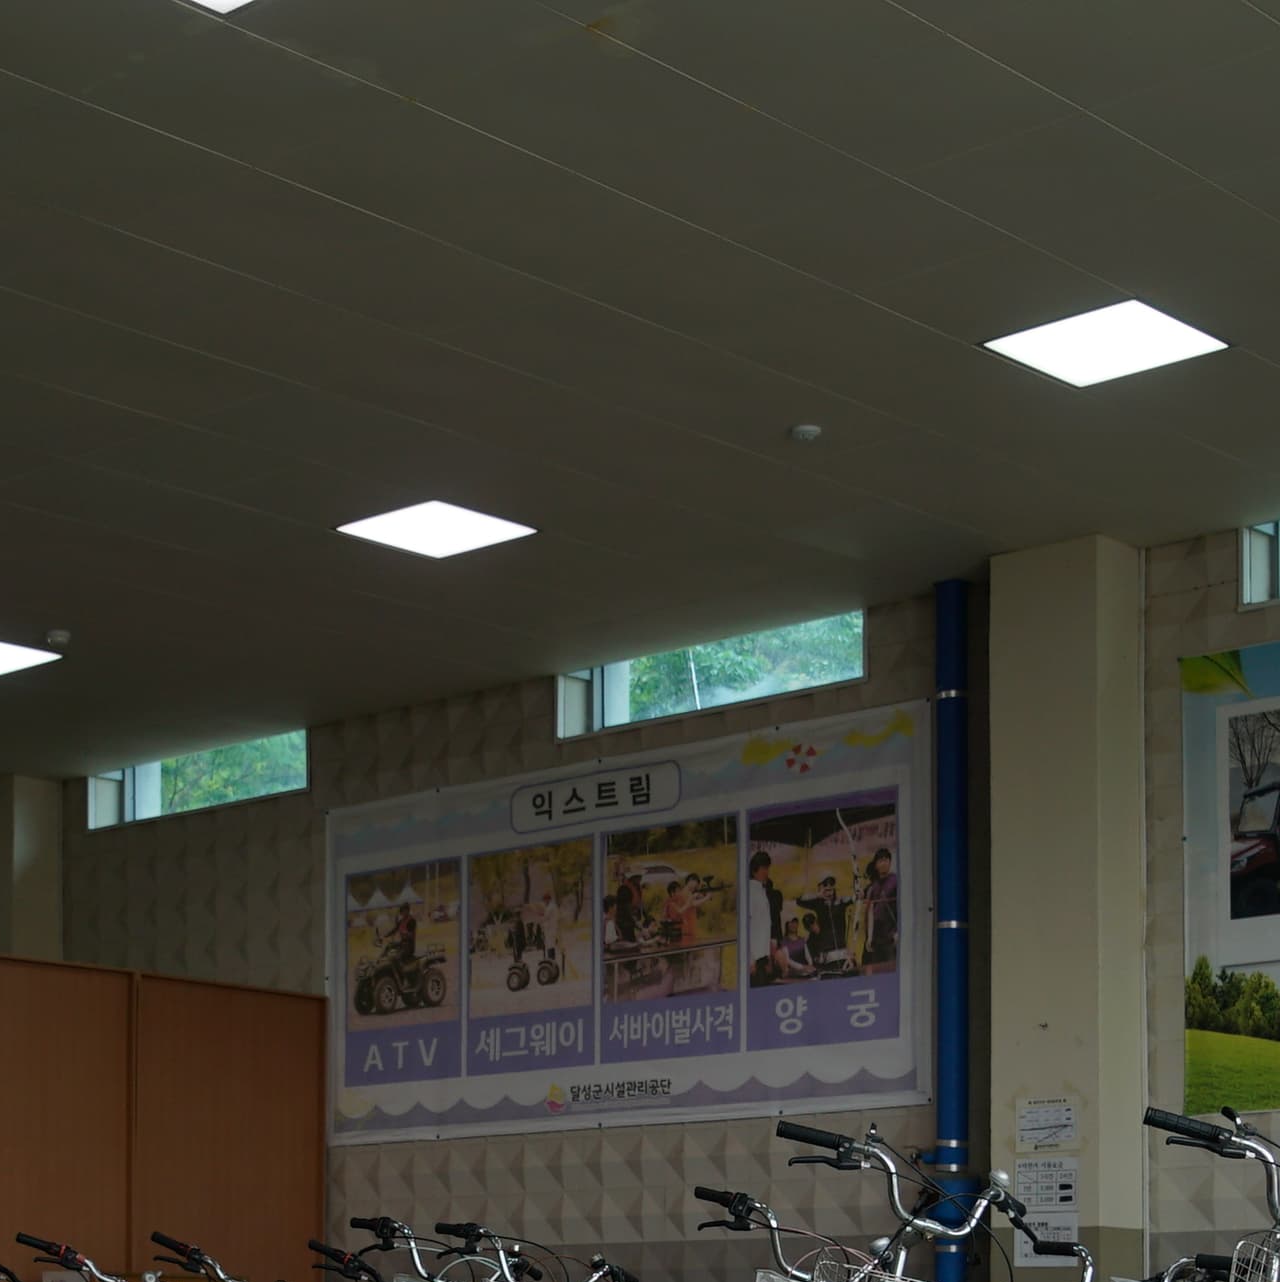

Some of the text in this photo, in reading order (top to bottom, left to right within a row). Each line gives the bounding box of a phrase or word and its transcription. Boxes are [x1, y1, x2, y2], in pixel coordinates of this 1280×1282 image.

[531, 773, 653, 821] 익스트림
[475, 1018, 584, 1065] 세그웨이
[609, 1003, 736, 1050] 서바이벌사격
[363, 1037, 439, 1073] ATV
[570, 1078, 672, 1101] 달성군시설관리공단
